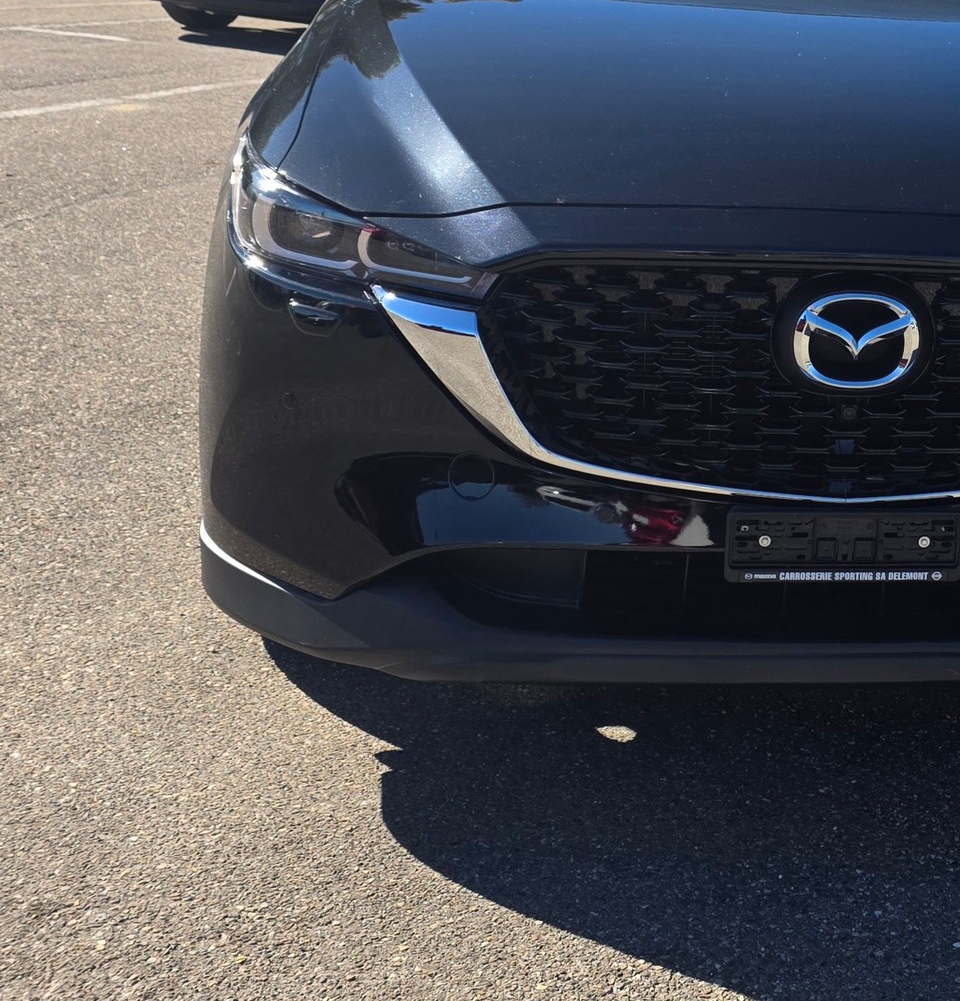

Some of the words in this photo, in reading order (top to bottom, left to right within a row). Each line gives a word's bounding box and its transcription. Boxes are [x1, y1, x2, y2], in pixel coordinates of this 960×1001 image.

[779, 571, 833, 581] CARROSSERIE
[834, 571, 874, 581] SPORTING
[875, 571, 887, 581] SA
[888, 571, 929, 581] DELEMONT
